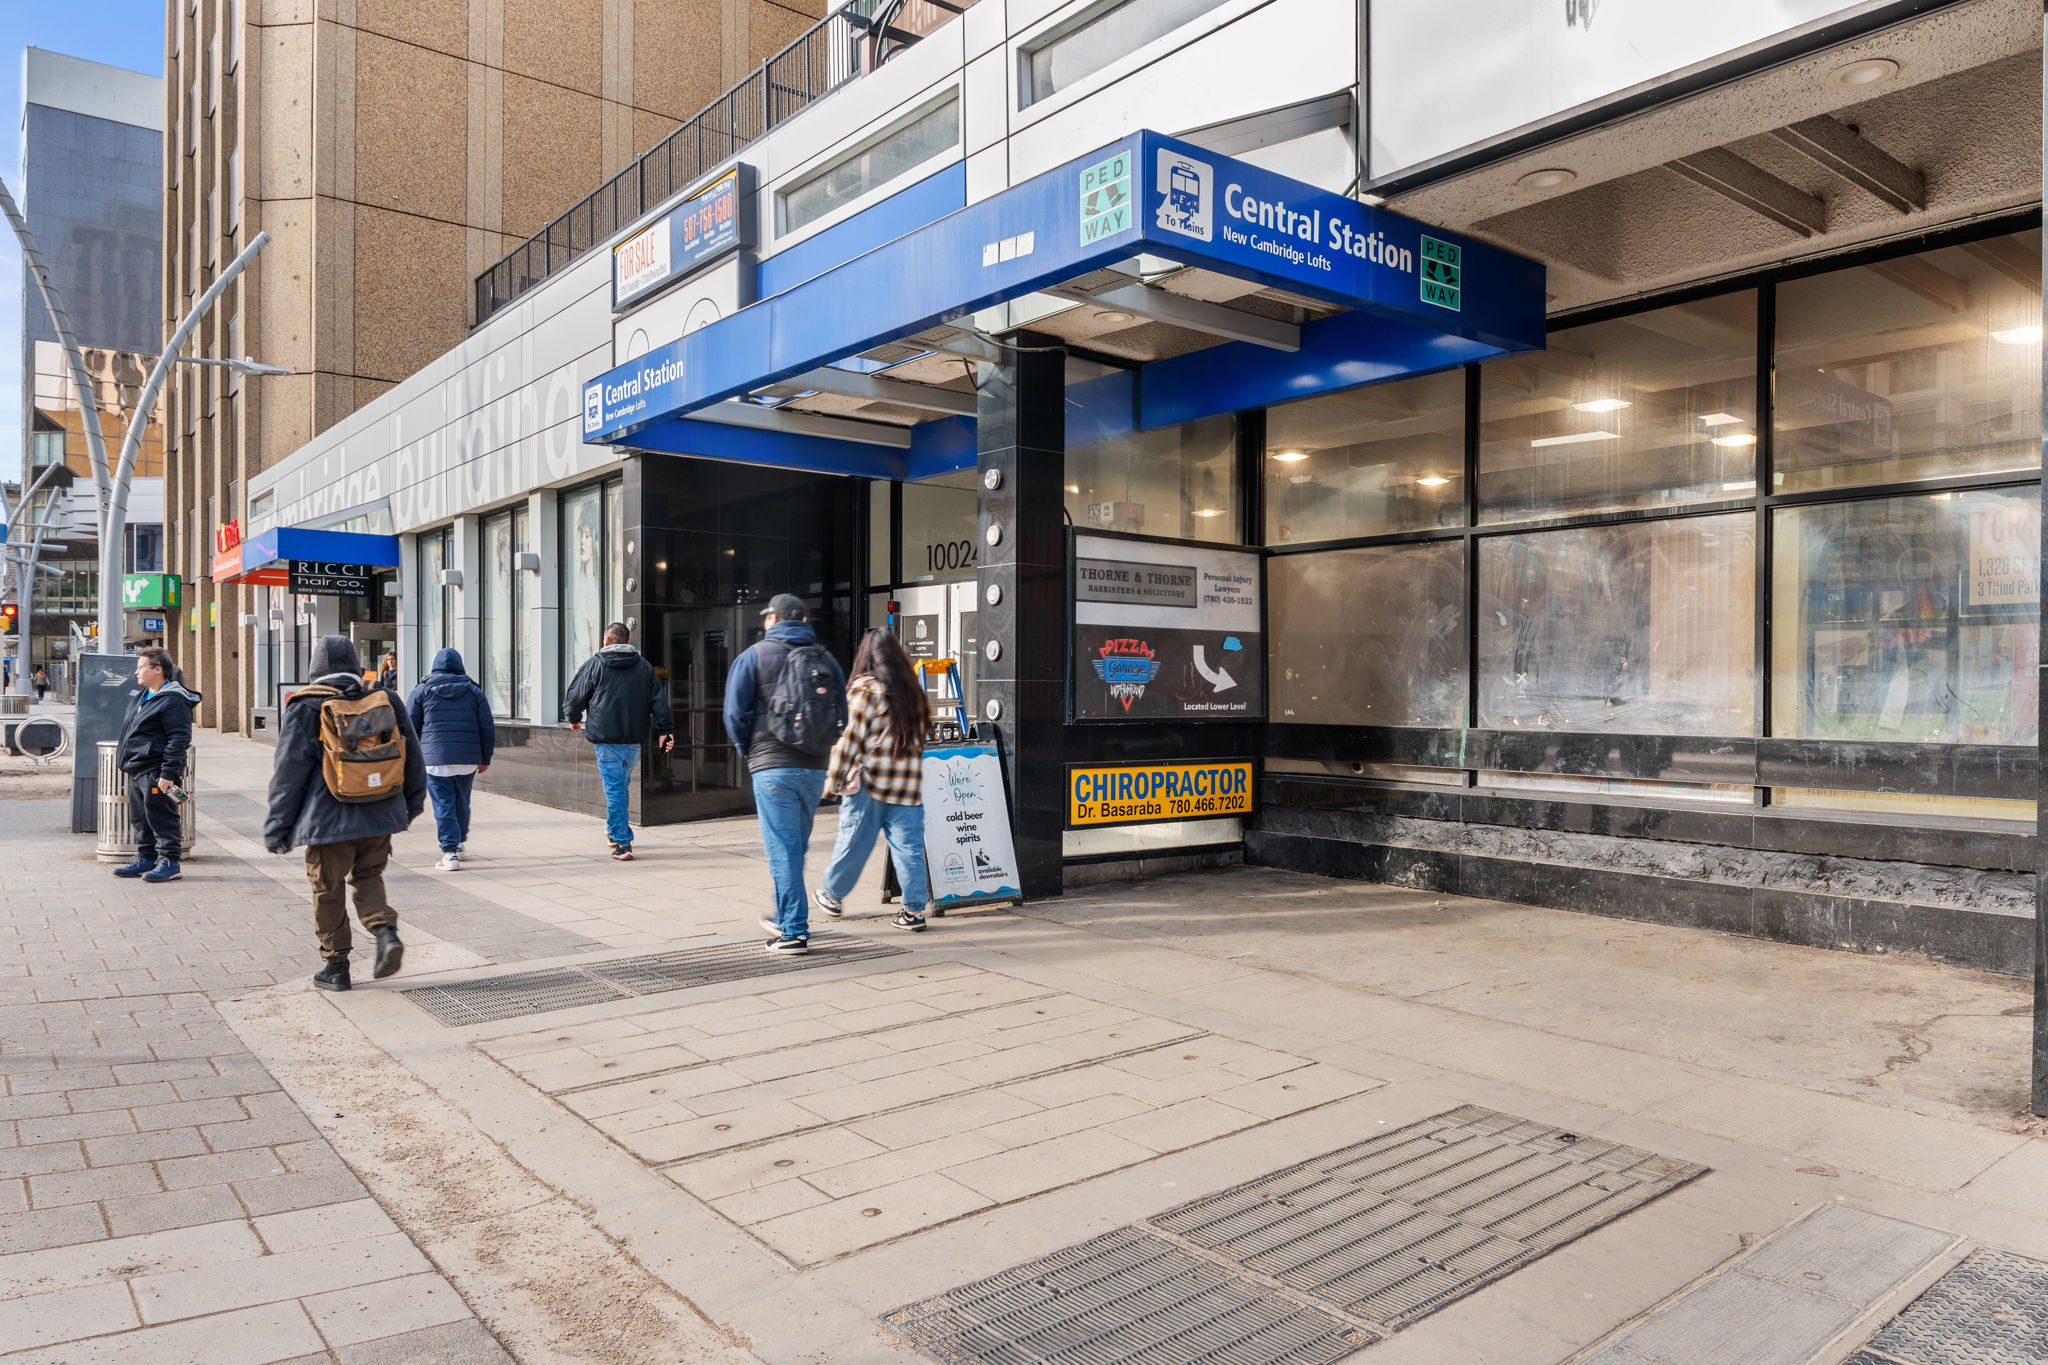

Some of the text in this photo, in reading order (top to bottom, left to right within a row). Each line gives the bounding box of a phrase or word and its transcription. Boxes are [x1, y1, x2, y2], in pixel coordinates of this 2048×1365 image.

[1085, 159, 1124, 191] PED
[1085, 209, 1124, 241] WAY
[1165, 213, 1176, 227] To
[1224, 183, 1413, 274] Central Station
[1223, 225, 1331, 272] New Cambridge Lofts
[1426, 240, 1456, 263] PED
[619, 246, 635, 283] FOR
[635, 231, 656, 273] SALE
[1425, 284, 1456, 305] WAY
[605, 359, 684, 406] Central Station
[298, 562, 364, 576] RICCI
[1977, 556, 2010, 577] 1,328
[298, 577, 364, 588] hair co.
[1080, 567, 1193, 587] THORNE & THORNE
[1203, 573, 1253, 585] Personal Injury
[1088, 585, 1135, 595] BARRISTERS
[1143, 589, 1185, 598] SOLICITORS
[1214, 585, 1241, 595] Lawyers
[1977, 581, 1984, 597] 3
[1203, 595, 1253, 605] (780) 426-1522
[1103, 639, 1152, 655] PIZZA
[1107, 662, 1149, 678] Garage
[1184, 702, 1247, 711] Located Lower Level
[1075, 768, 1247, 803] CHIROPRACTOR
[954, 788, 977, 805] Open
[1078, 795, 1245, 819] Dr. Basaraba 780.466.7202
[946, 810, 983, 822] cold beer
[956, 822, 977, 832] wine
[956, 833, 981, 846] spirits
[978, 865, 1002, 874] available
[979, 872, 1008, 880] downstairs
